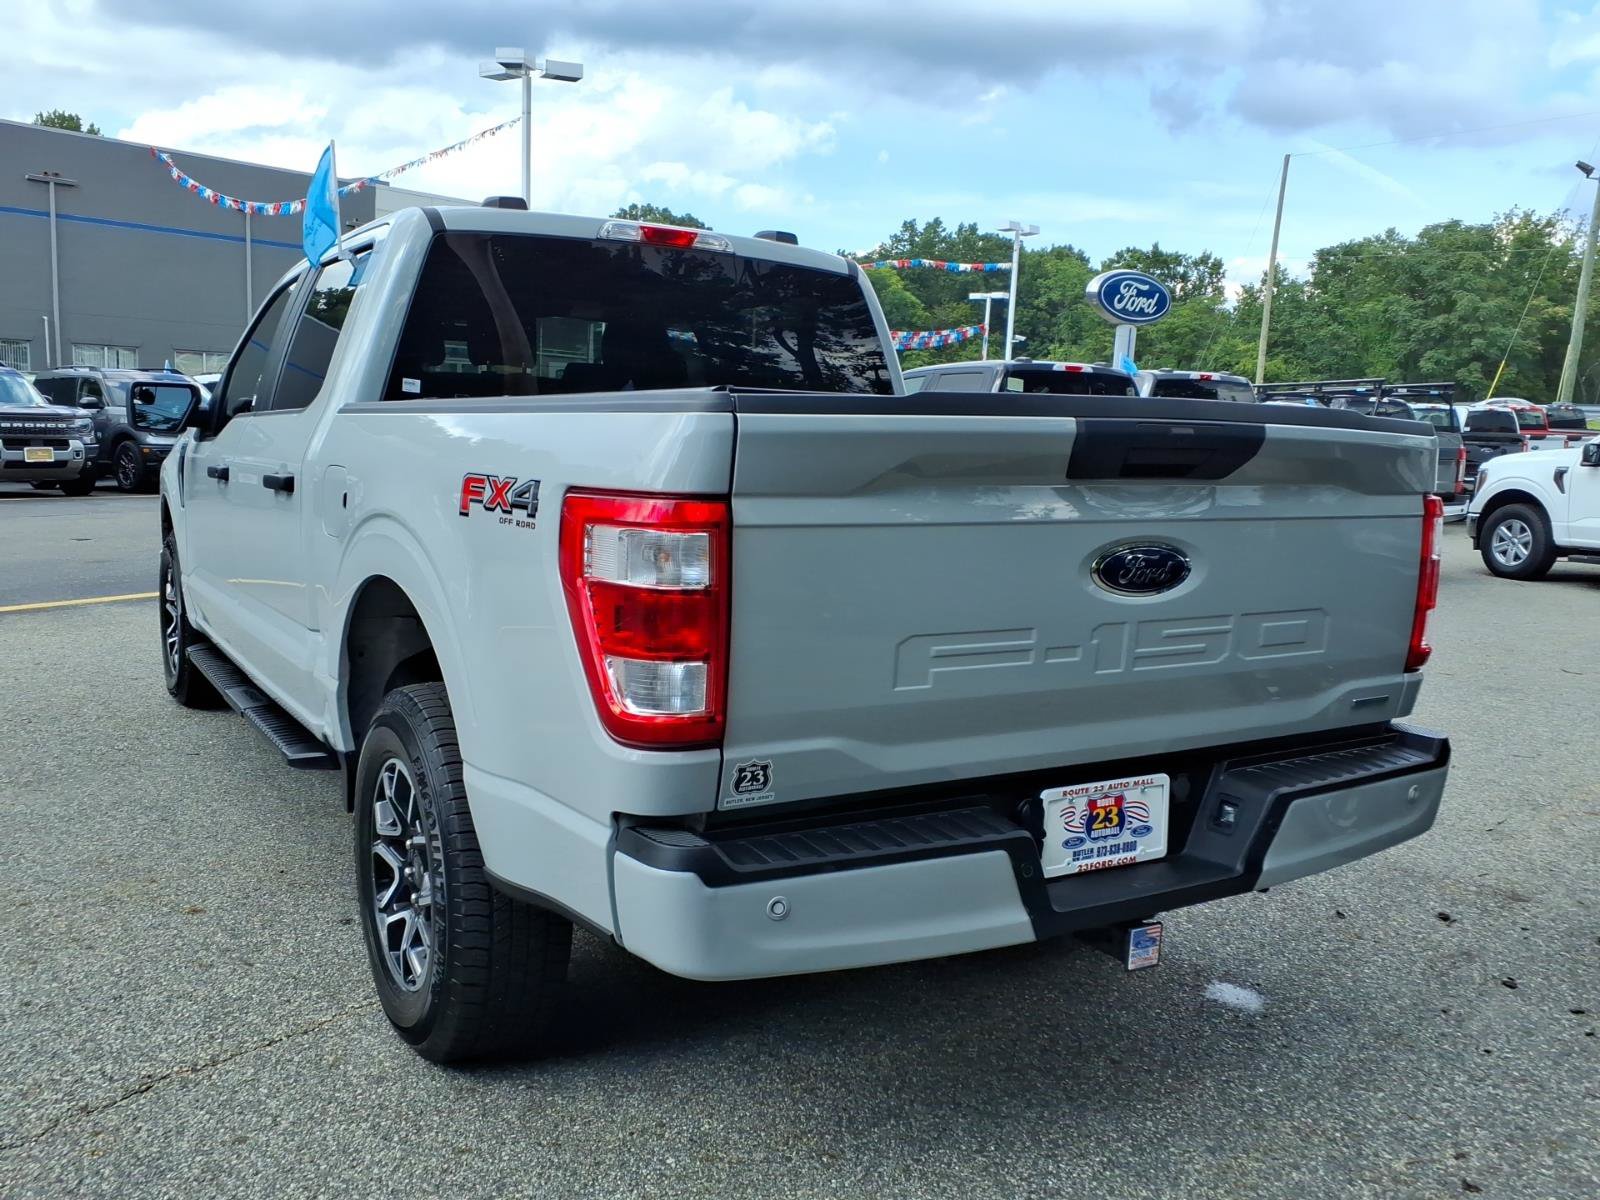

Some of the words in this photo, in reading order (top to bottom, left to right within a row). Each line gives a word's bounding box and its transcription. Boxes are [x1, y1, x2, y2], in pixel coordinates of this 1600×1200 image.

[1114, 281, 1159, 313] Ford
[459, 472, 541, 519] FX4
[499, 517, 513, 525] OFF
[516, 520, 536, 530] ROAD
[1119, 554, 1175, 584] Ford
[893, 608, 1330, 691] F-150
[740, 770, 765, 787] 23
[1062, 788, 1089, 797] ROUTE
[1107, 782, 1130, 790] AUTO
[1132, 778, 1154, 786] MALL
[1096, 797, 1115, 807] ROUTE
[1092, 806, 1119, 829] 23
[1072, 848, 1094, 857] BUTLER
[1077, 856, 1137, 872] 23FORD.COM
